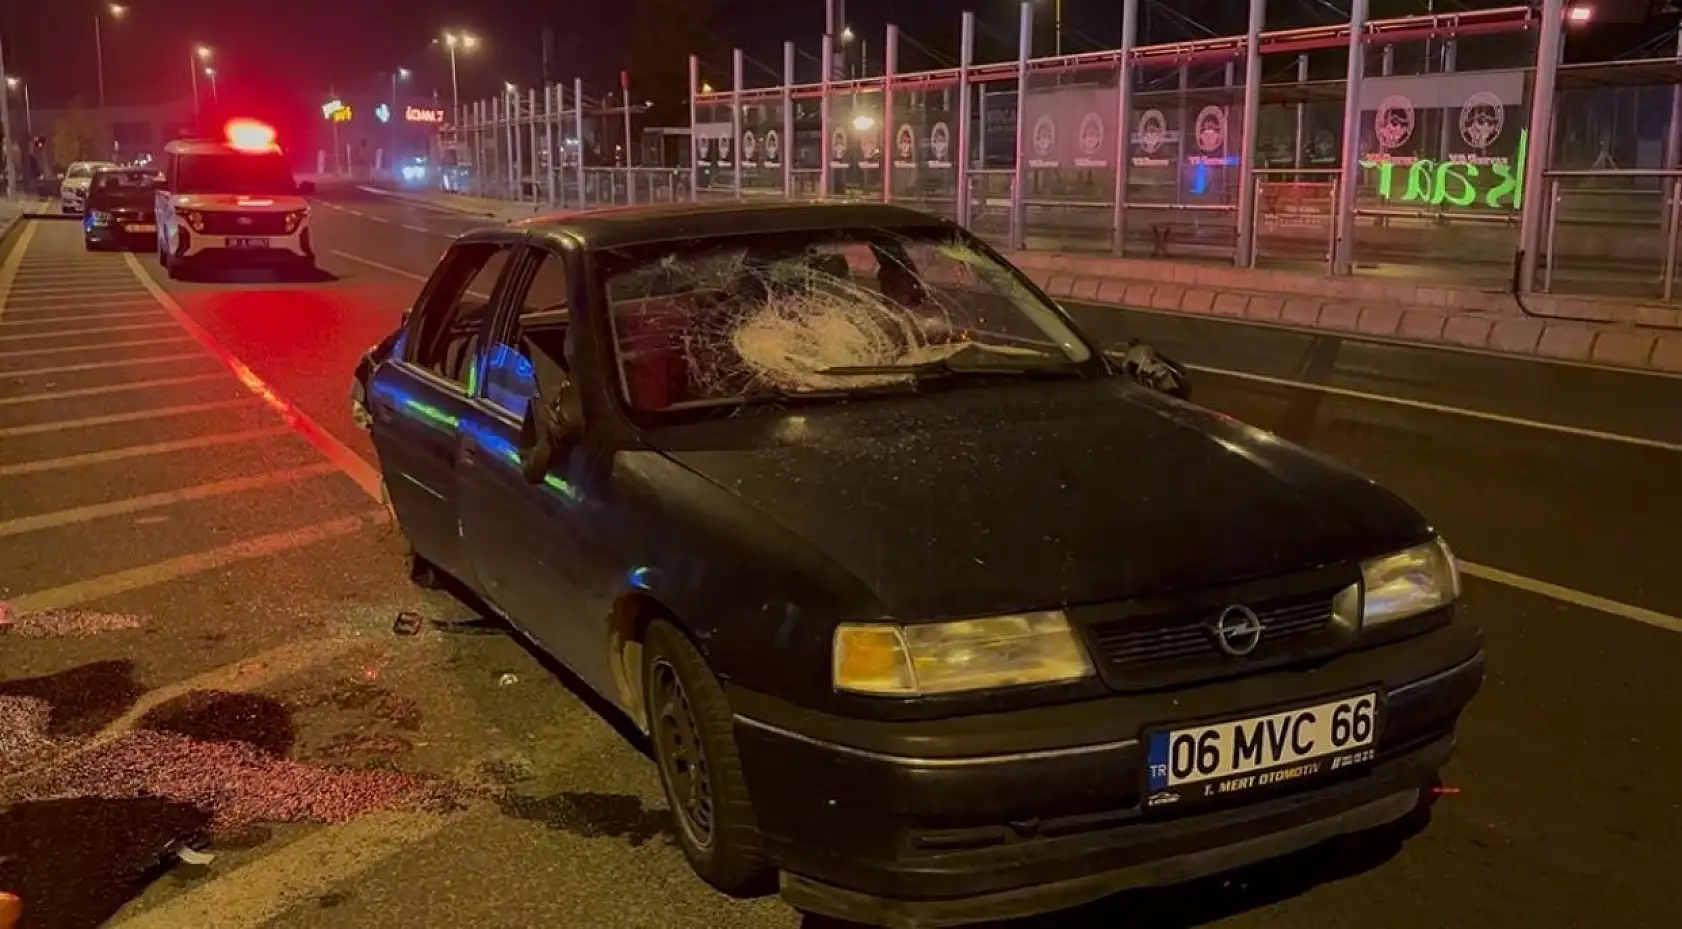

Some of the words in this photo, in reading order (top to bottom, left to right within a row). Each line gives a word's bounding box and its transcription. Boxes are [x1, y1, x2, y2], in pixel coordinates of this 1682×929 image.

[1171, 731, 1220, 778] 06
[1231, 712, 1316, 769] MVC
[1331, 699, 1373, 747] 66
[1151, 764, 1167, 777] TR
[1219, 776, 1255, 793] MERT
